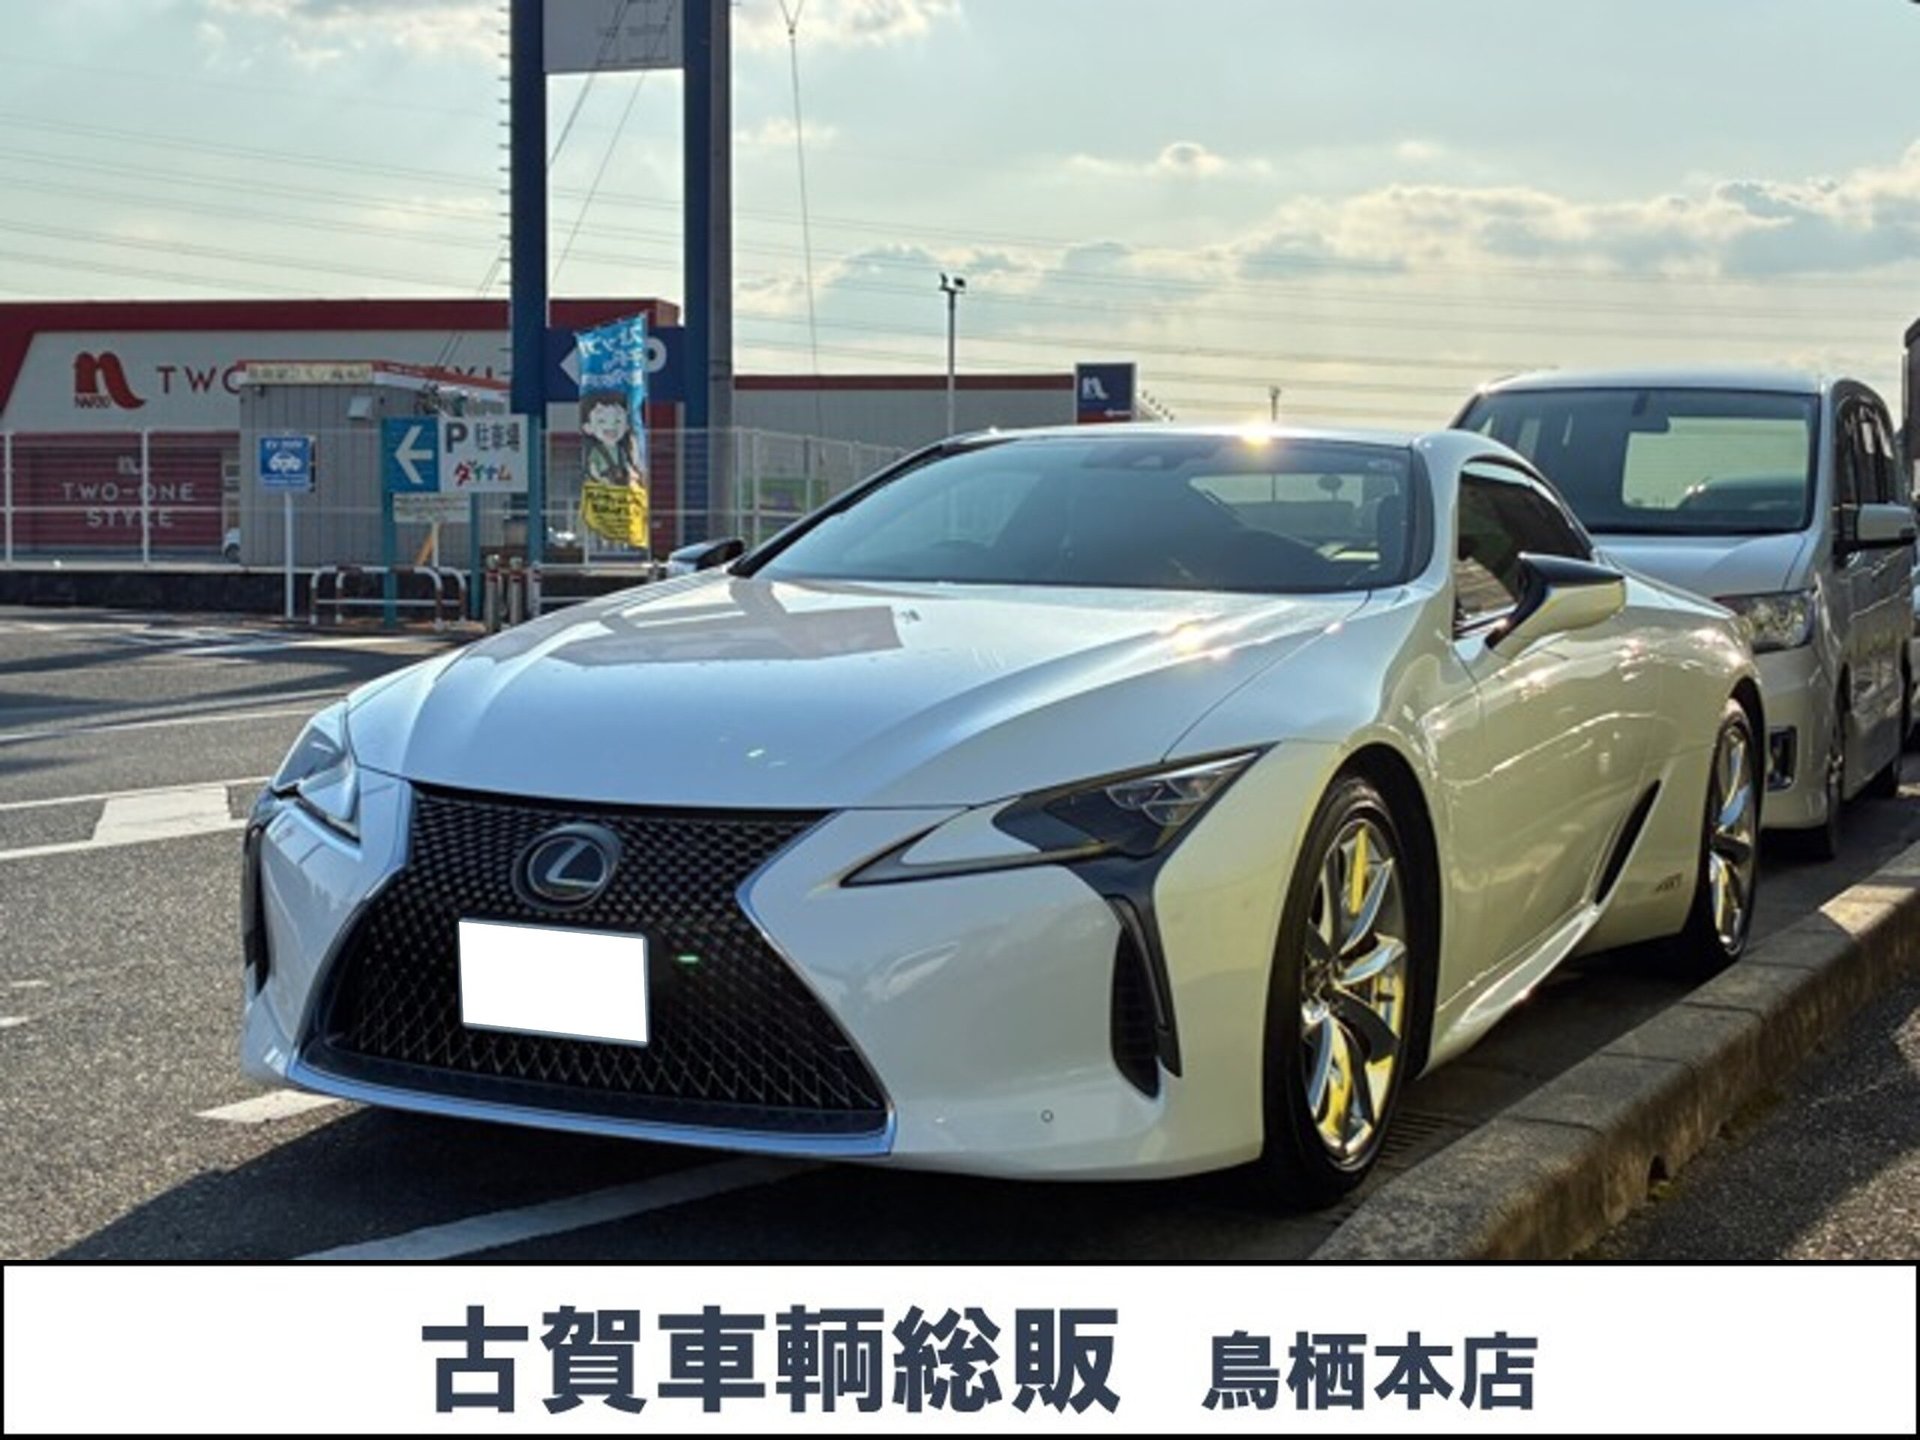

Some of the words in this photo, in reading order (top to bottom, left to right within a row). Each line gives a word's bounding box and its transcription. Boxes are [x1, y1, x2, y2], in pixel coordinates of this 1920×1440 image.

[445, 422, 468, 453] P
[454, 460, 512, 486] ダイナム
[64, 483, 194, 501] TWO-ONE
